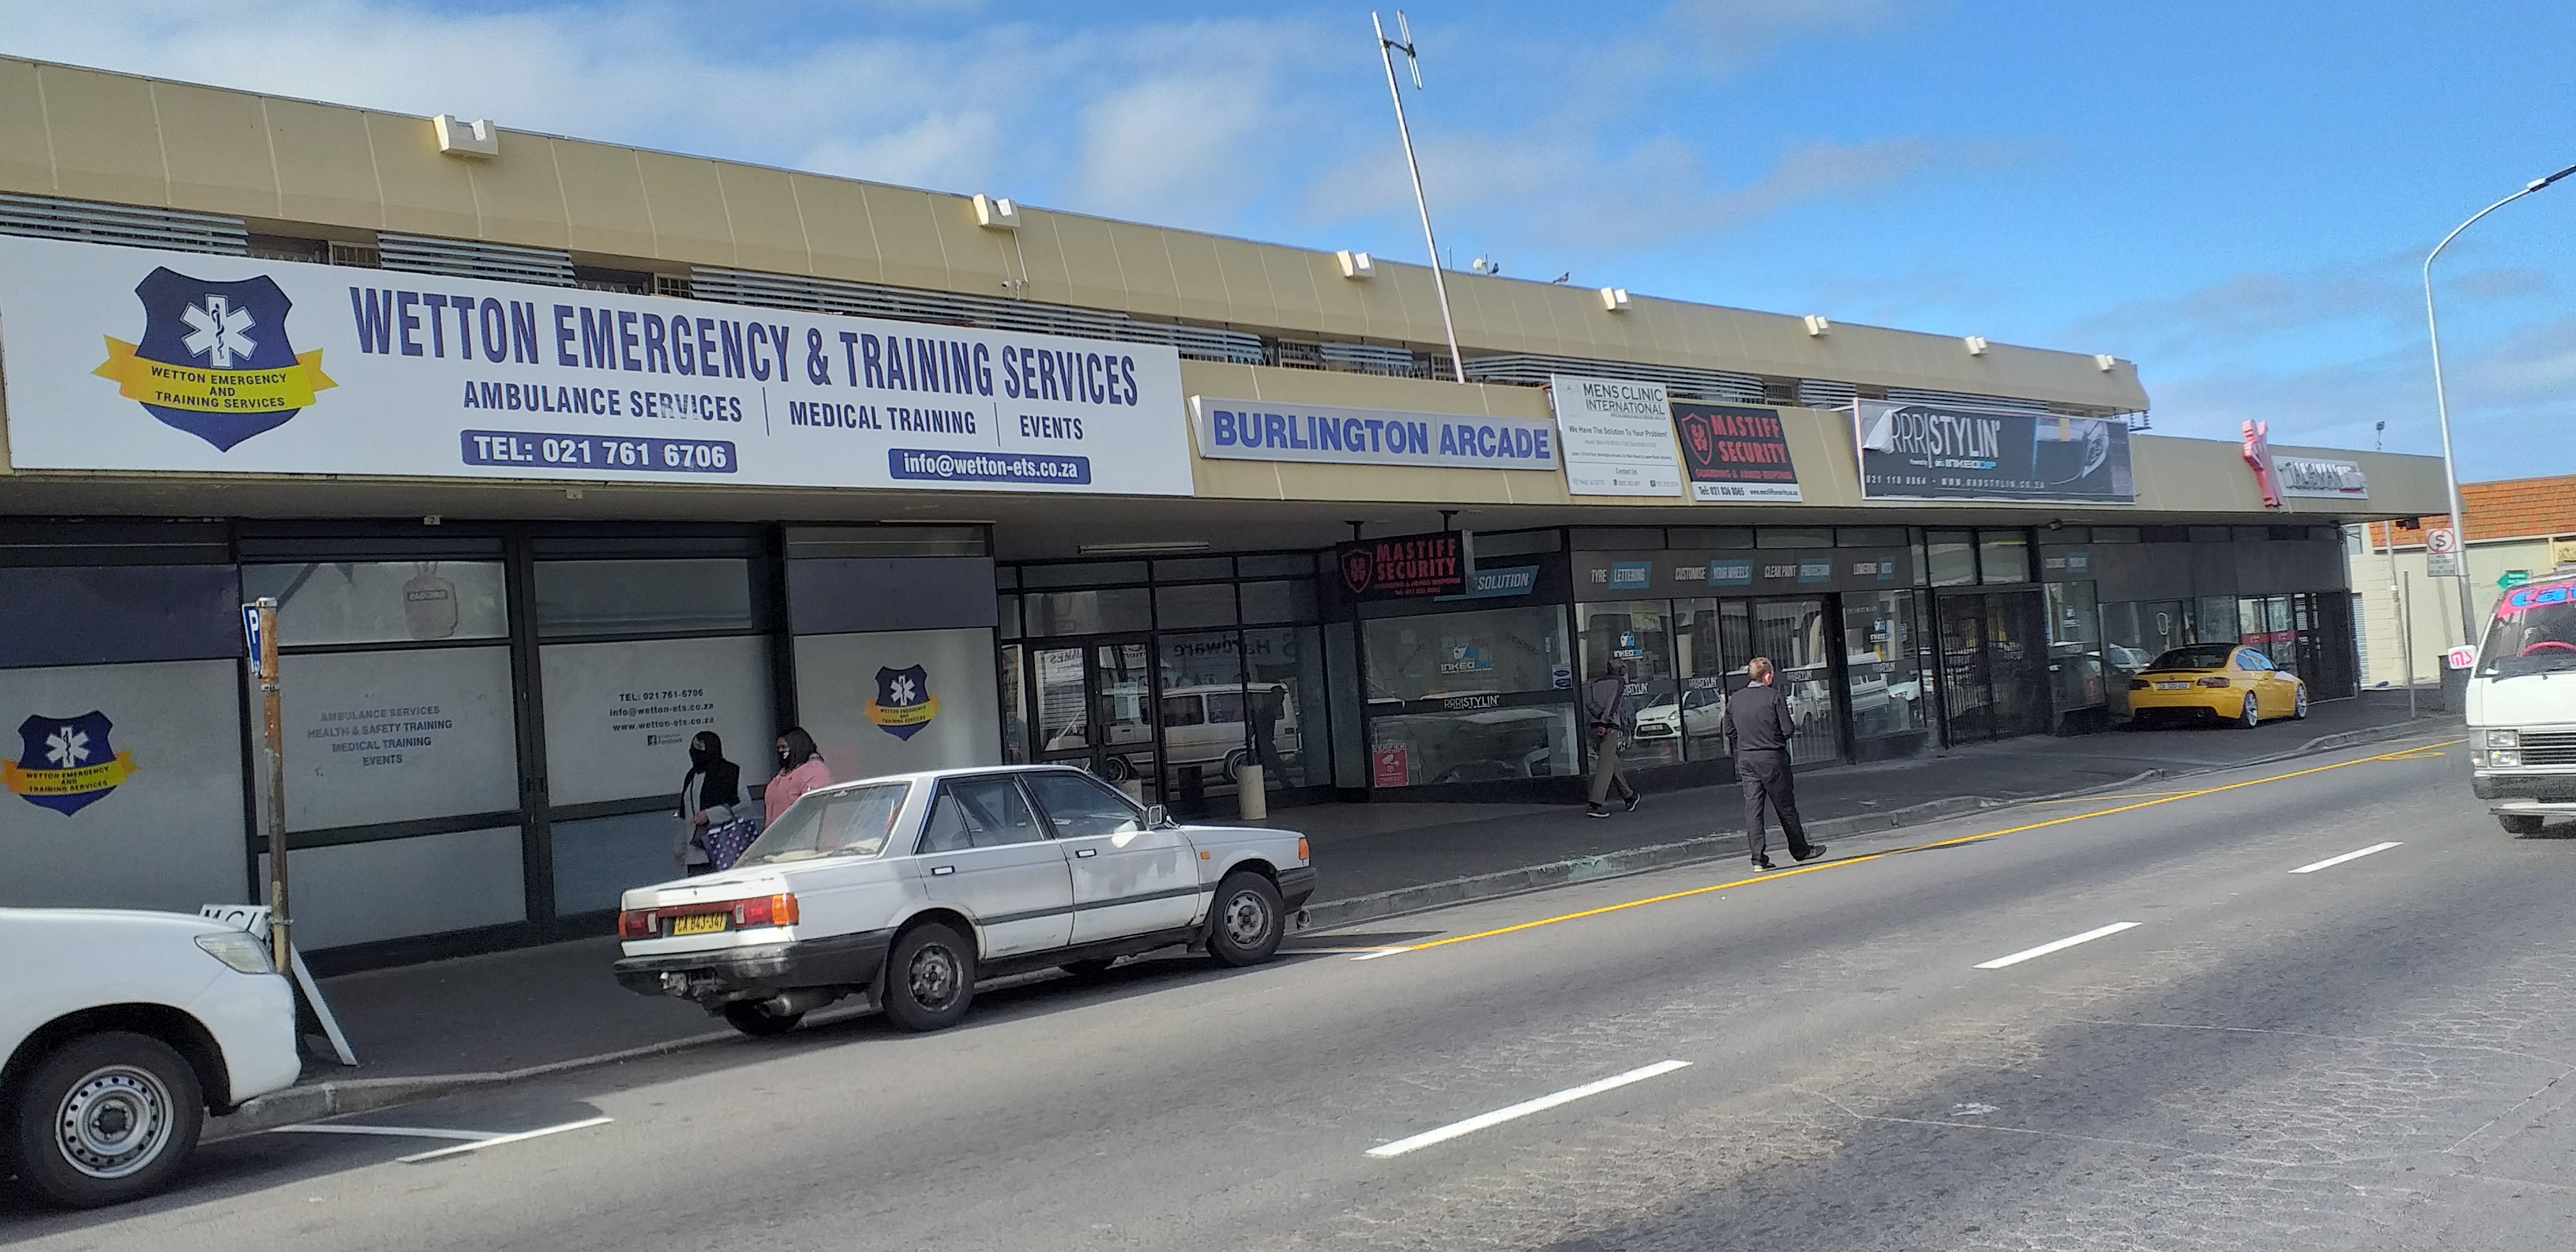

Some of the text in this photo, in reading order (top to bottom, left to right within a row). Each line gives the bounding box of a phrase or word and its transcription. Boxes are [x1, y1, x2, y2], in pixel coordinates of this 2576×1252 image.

[349, 286, 1138, 407] WETTON EMERGENCY & TRAINING SERVICES
[151, 365, 286, 385] WETTON EMERGENCY
[155, 390, 285, 408] TRAINING SERVICES
[210, 386, 235, 397] AND
[1583, 383, 1663, 402] MENS CLINIC
[463, 381, 742, 422] AMBULANCE SERVICES
[1586, 399, 1666, 415] INTERNATIONAL
[789, 401, 977, 435] MEDICAL TRAINING
[1710, 415, 1779, 438] MASTIFF
[1020, 415, 1084, 439] EVENTS
[1213, 410, 1551, 459] BURLINGTON ARCADE
[1604, 427, 1625, 436] Solution
[473, 435, 727, 468] TEL: 021 761 6706
[1719, 440, 1786, 464] SECURITY
[903, 452, 1078, 479] info@wetton-ets.co.za
[1866, 475, 1882, 484] 021
[1710, 487, 1721, 496] 021
[1376, 538, 1456, 563] MASTIFF
[1377, 558, 1456, 581] SECURITY
[1591, 568, 1645, 583] TYRE LETTERING
[1675, 566, 1749, 581] CUSTOMISE YOUR WHEELS
[1765, 565, 1781, 578] CLEAR
[1782, 565, 1797, 577] PAINT
[1478, 573, 1529, 590] SOLUTION
[249, 609, 259, 644] P
[643, 692, 659, 700] 021
[662, 689, 703, 699] 761-6706
[321, 706, 440, 722] AMBULANCE SERVICES
[610, 703, 714, 717] info@wetton-ets.co.za
[307, 720, 452, 739] HEALTH & SAFETY TRAINING
[613, 717, 714, 731] www.wetton-ets.co.za
[332, 737, 431, 753] MEDICAL TRAINING
[362, 754, 402, 767] EVENTS
[62, 767, 110, 778] EMERGENCY
[70, 780, 108, 792] SERVICES
